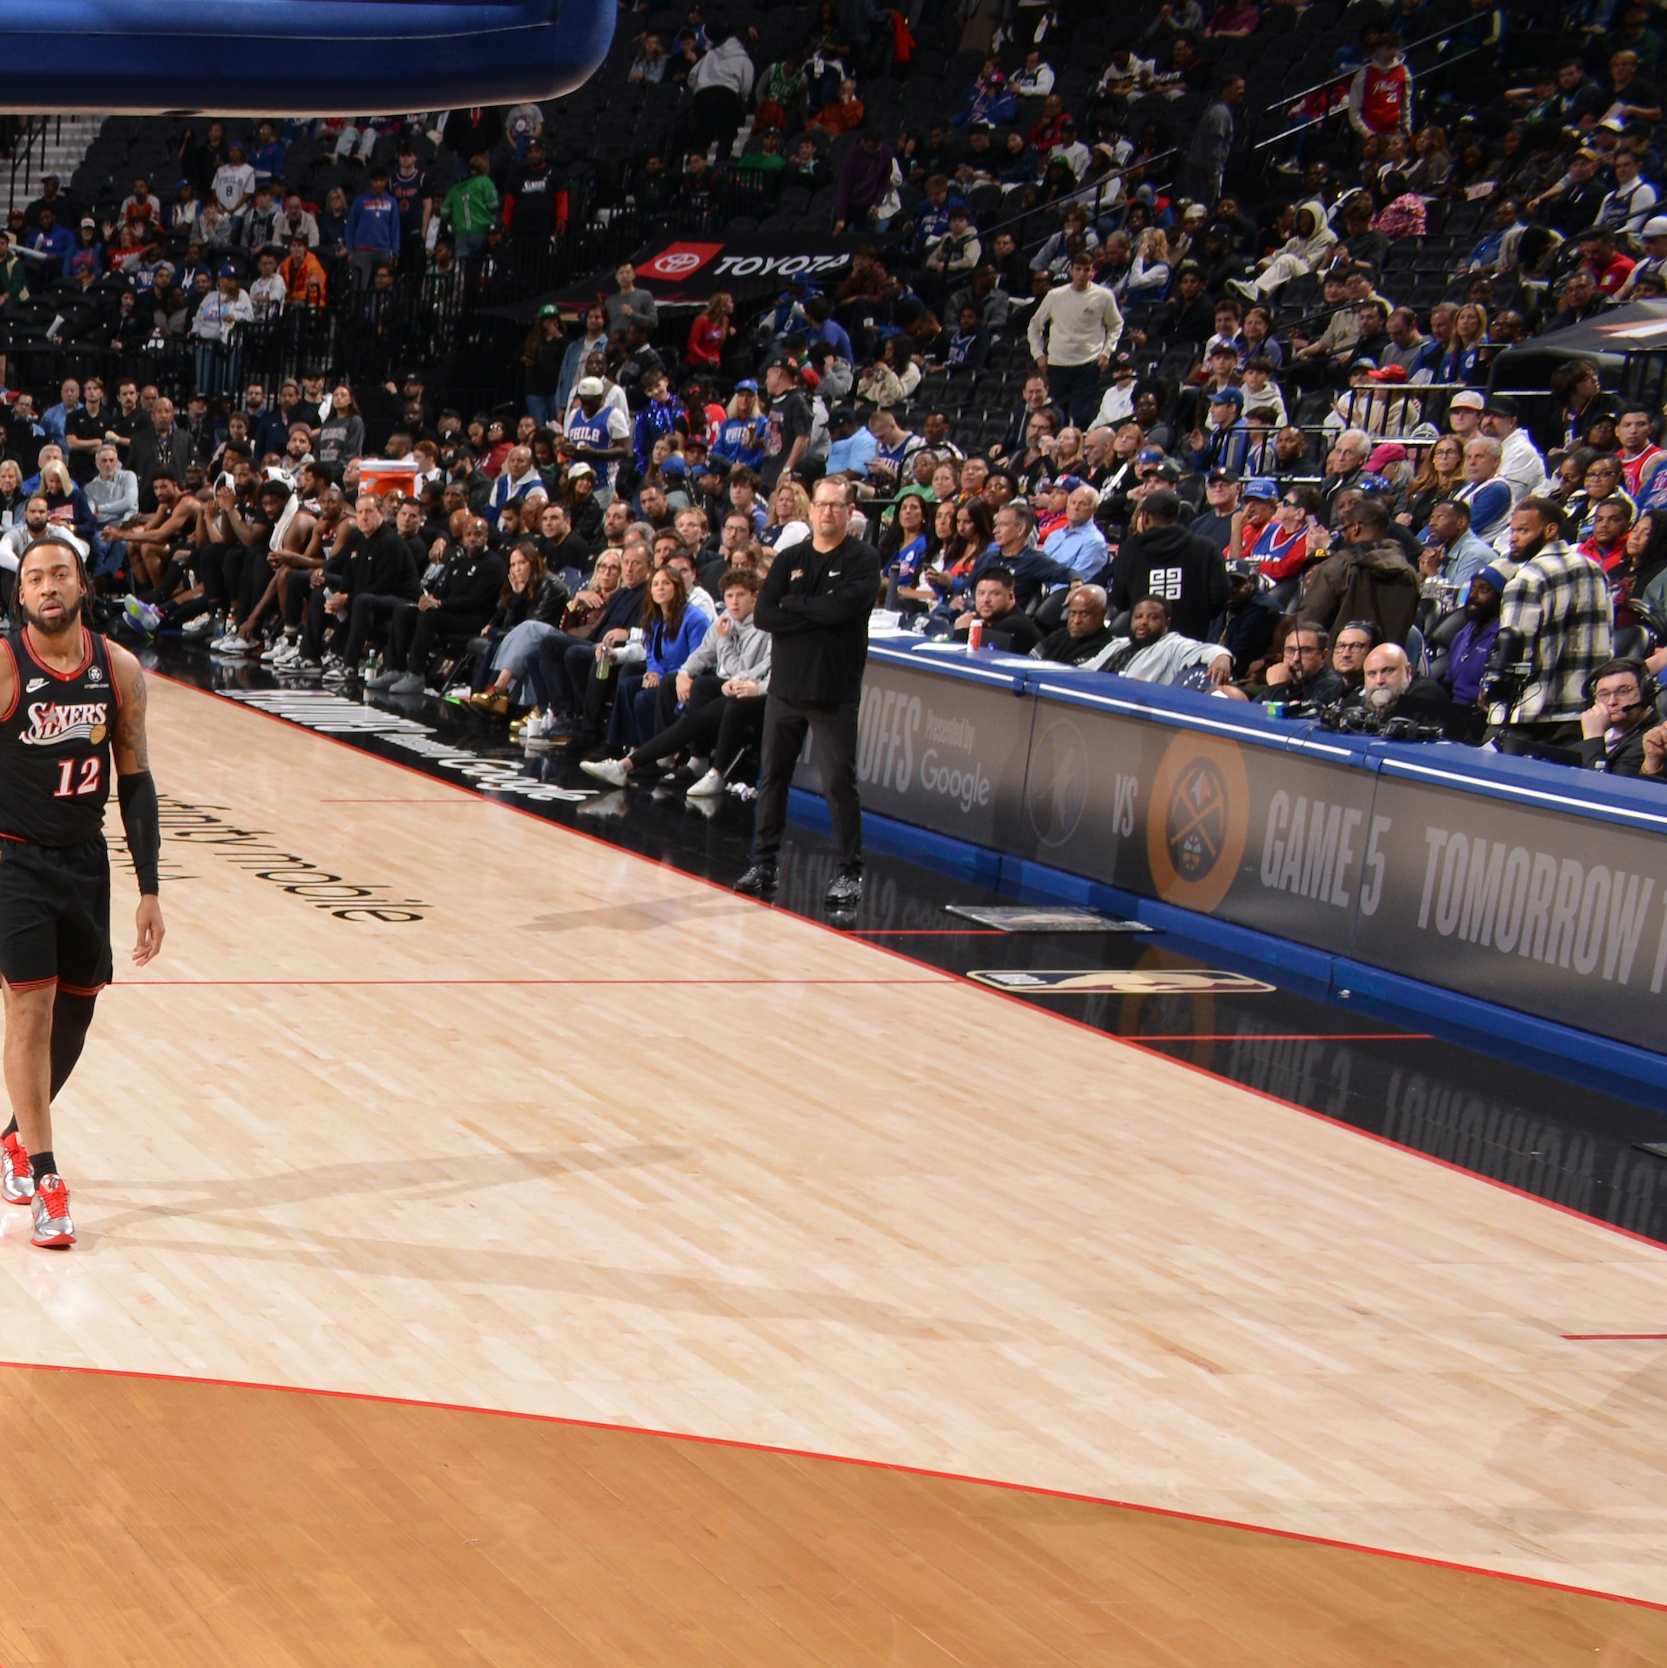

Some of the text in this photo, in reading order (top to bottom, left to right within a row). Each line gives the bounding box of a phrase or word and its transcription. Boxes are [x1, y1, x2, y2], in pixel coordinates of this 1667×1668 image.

[225, 185, 234, 197] 8
[713, 253, 851, 277] TOYOTA
[25, 701, 108, 741] SIXERS
[53, 756, 102, 797] 12
[920, 747, 990, 813] Google
[1112, 773, 1138, 838] VS
[1261, 789, 1392, 917] GAME 5
[214, 851, 434, 923] mobile
[1418, 826, 1656, 986] TOMORROW
